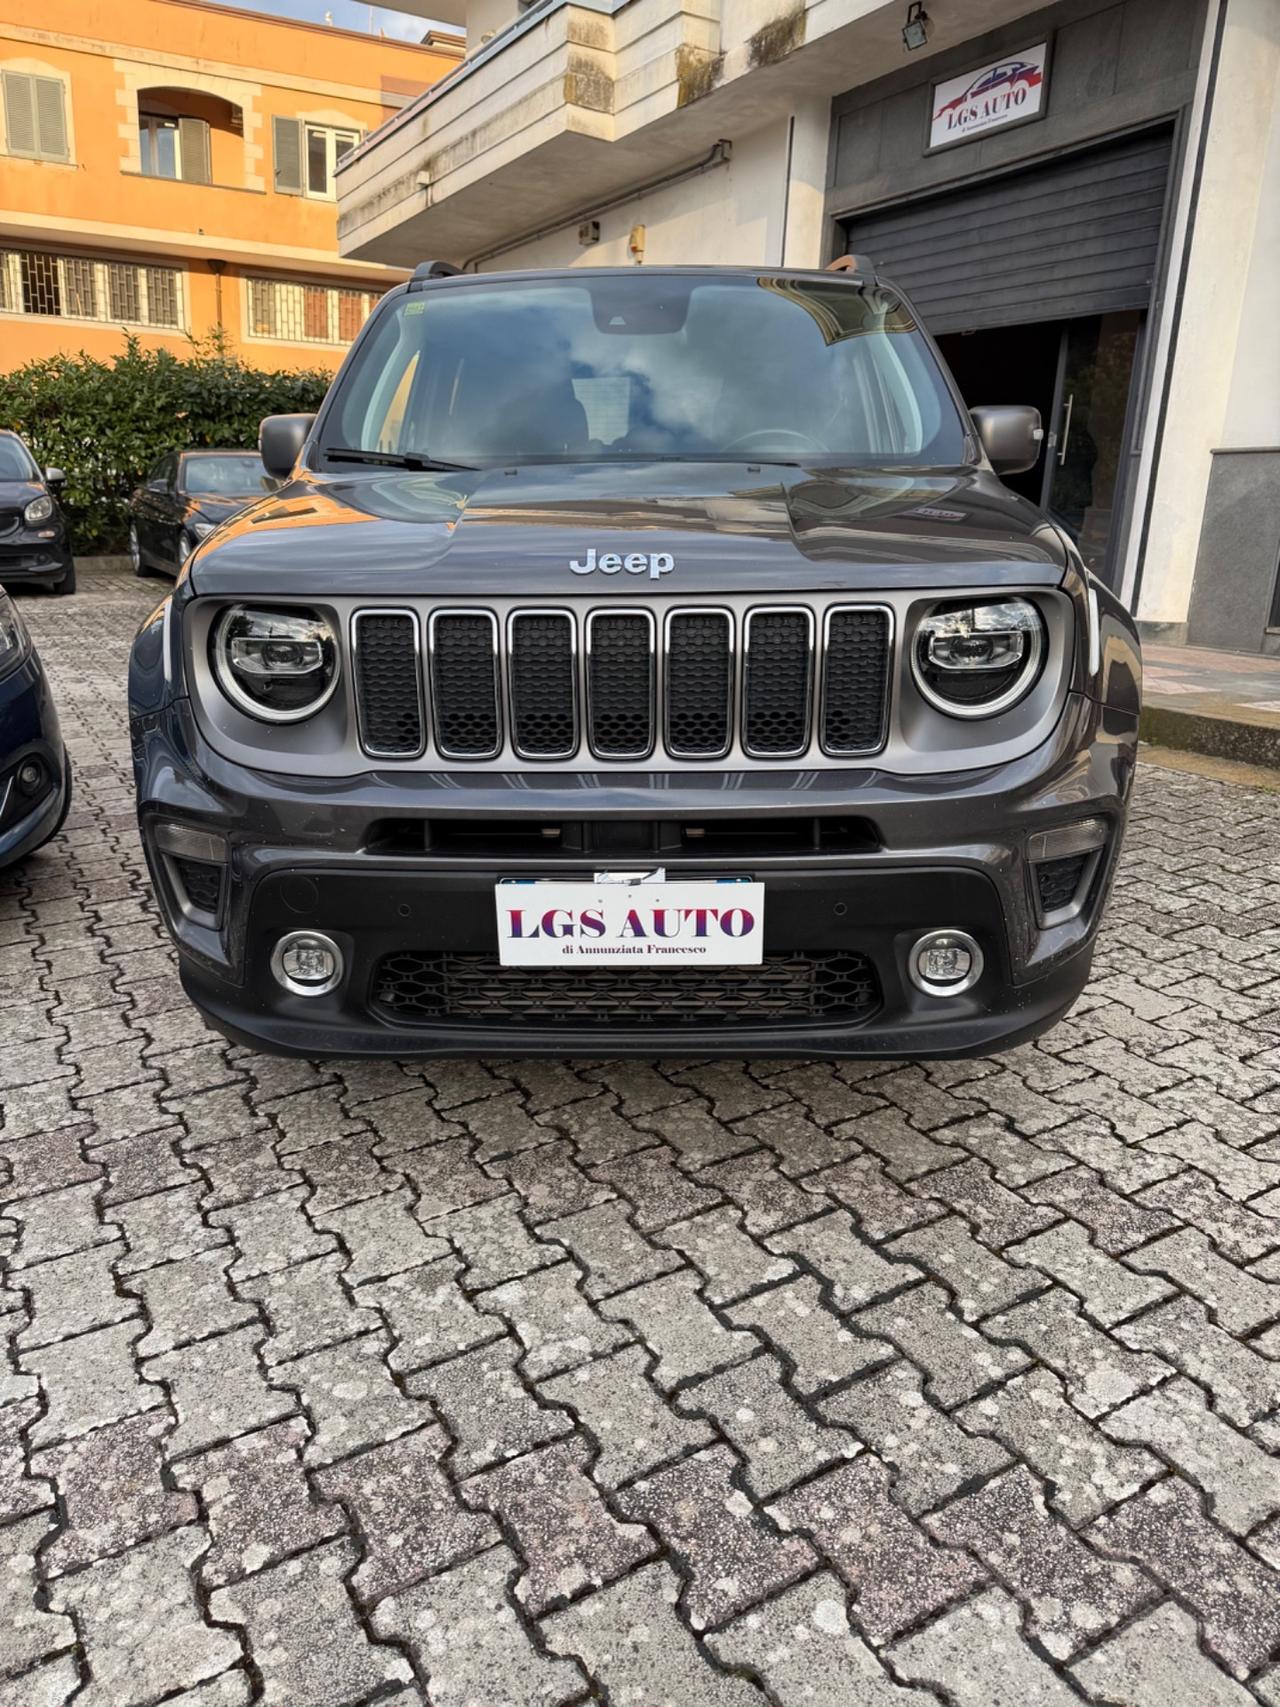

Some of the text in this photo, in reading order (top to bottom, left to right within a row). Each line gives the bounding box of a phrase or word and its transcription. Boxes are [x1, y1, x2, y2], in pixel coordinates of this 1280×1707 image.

[947, 105, 978, 130] LGS
[980, 87, 1027, 119] AUTO
[569, 548, 675, 579] Jeep
[506, 908, 755, 938] LGS AUTO
[562, 944, 707, 954] di Annunziata Francesco
